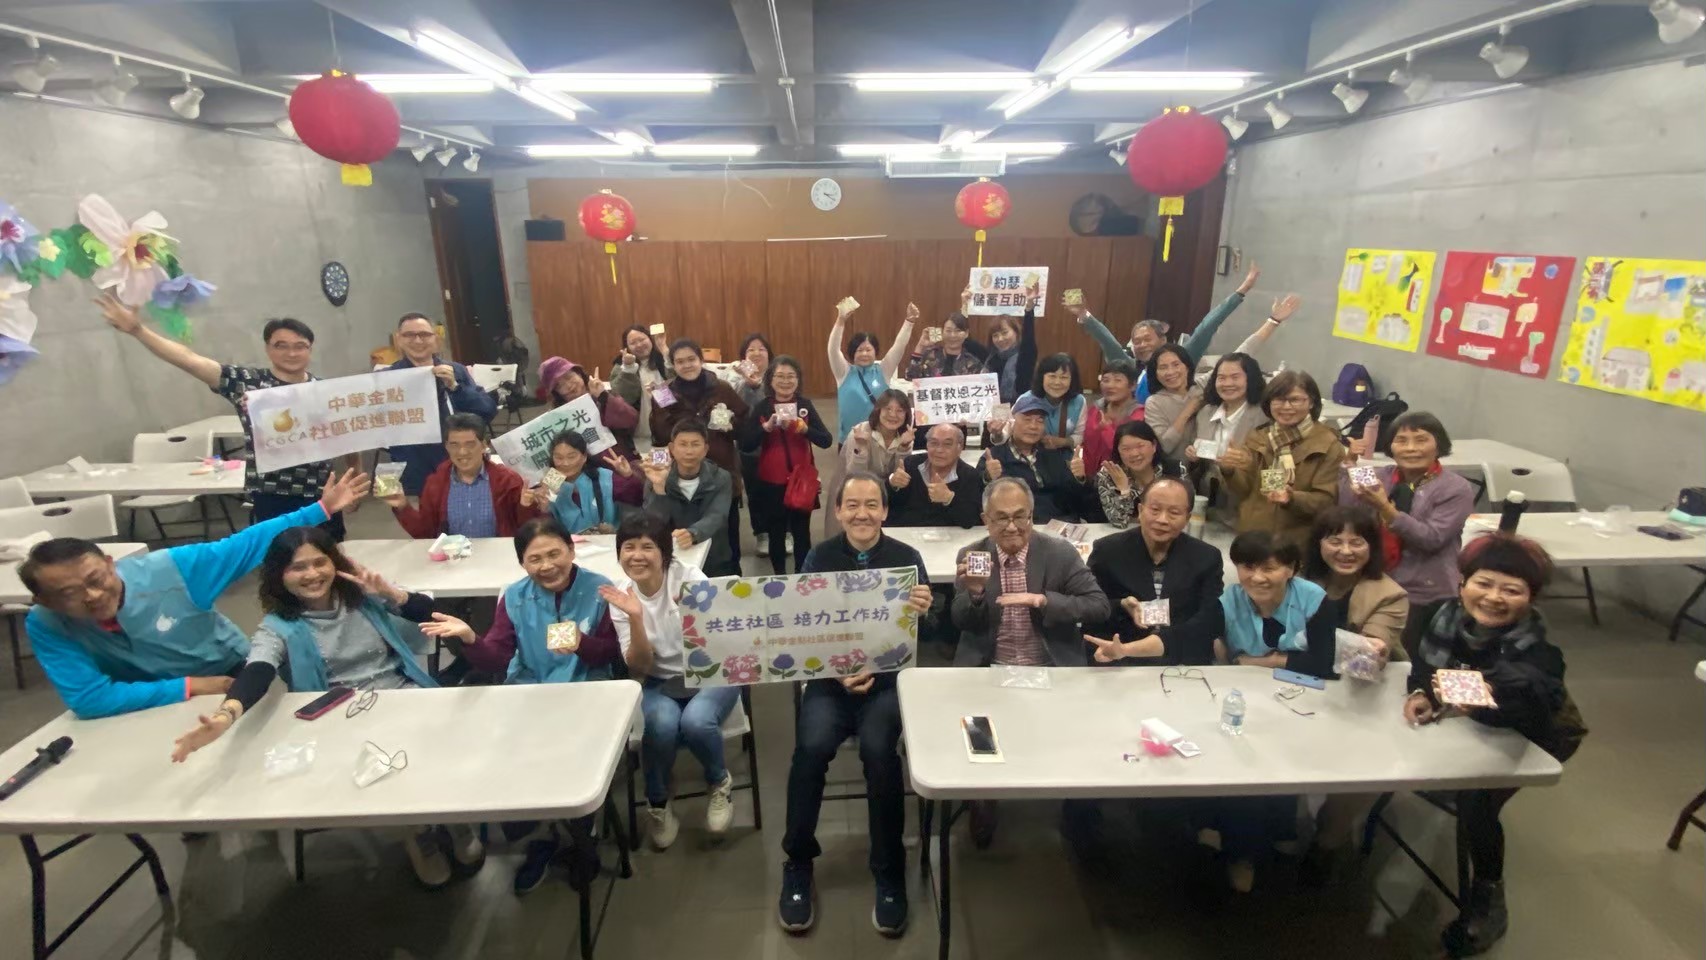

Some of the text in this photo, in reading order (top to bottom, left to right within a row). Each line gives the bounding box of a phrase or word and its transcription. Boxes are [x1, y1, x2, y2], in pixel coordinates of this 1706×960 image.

[994, 275, 1020, 290] 約瑟
[328, 386, 405, 413] 中華金點
[916, 384, 998, 402] 基督救恩之光
[944, 401, 971, 415] 教會
[309, 407, 426, 441] 社區促進聯盟
[520, 409, 591, 452] 城市之光
[266, 431, 308, 448] CGCA
[706, 606, 890, 633] 共生社區 培力工作坊
